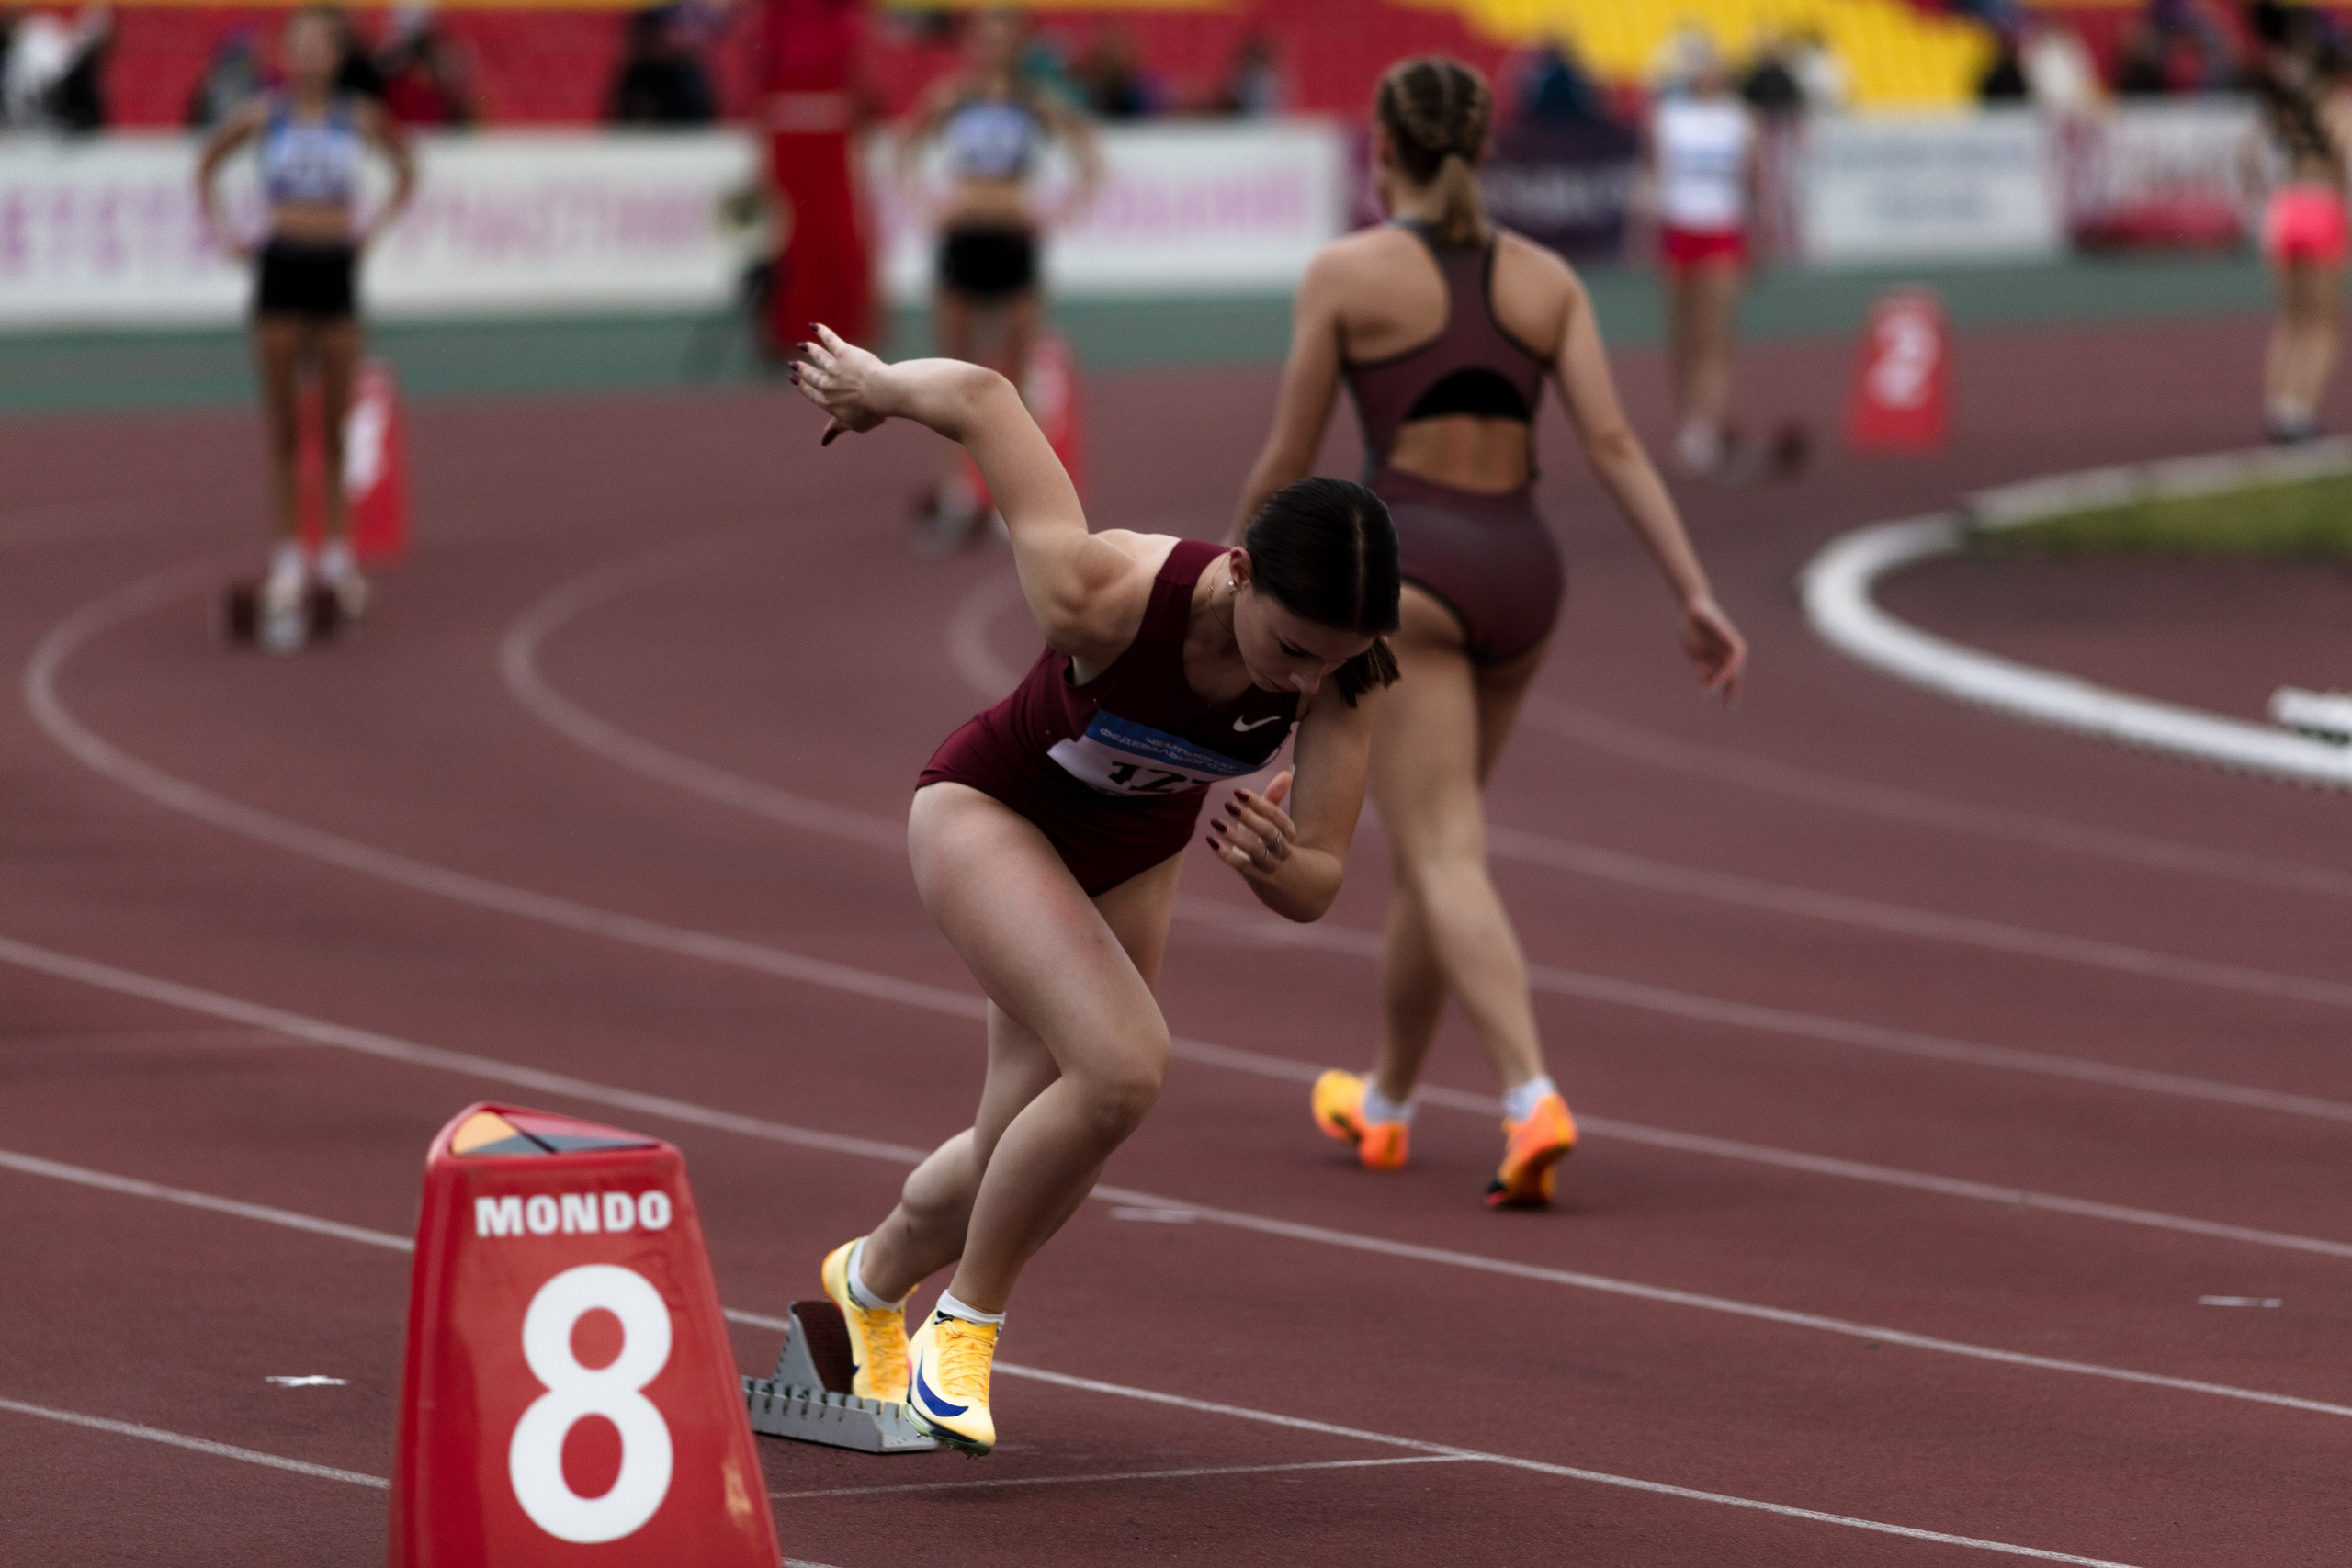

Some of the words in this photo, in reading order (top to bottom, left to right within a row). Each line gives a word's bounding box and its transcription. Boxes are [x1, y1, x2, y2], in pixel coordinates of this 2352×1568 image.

[1146, 737, 1237, 770] ЧЕМПИОНАТ
[1109, 761, 1213, 793] 12
[474, 1190, 672, 1237] MONDO
[509, 1264, 673, 1544] 8
